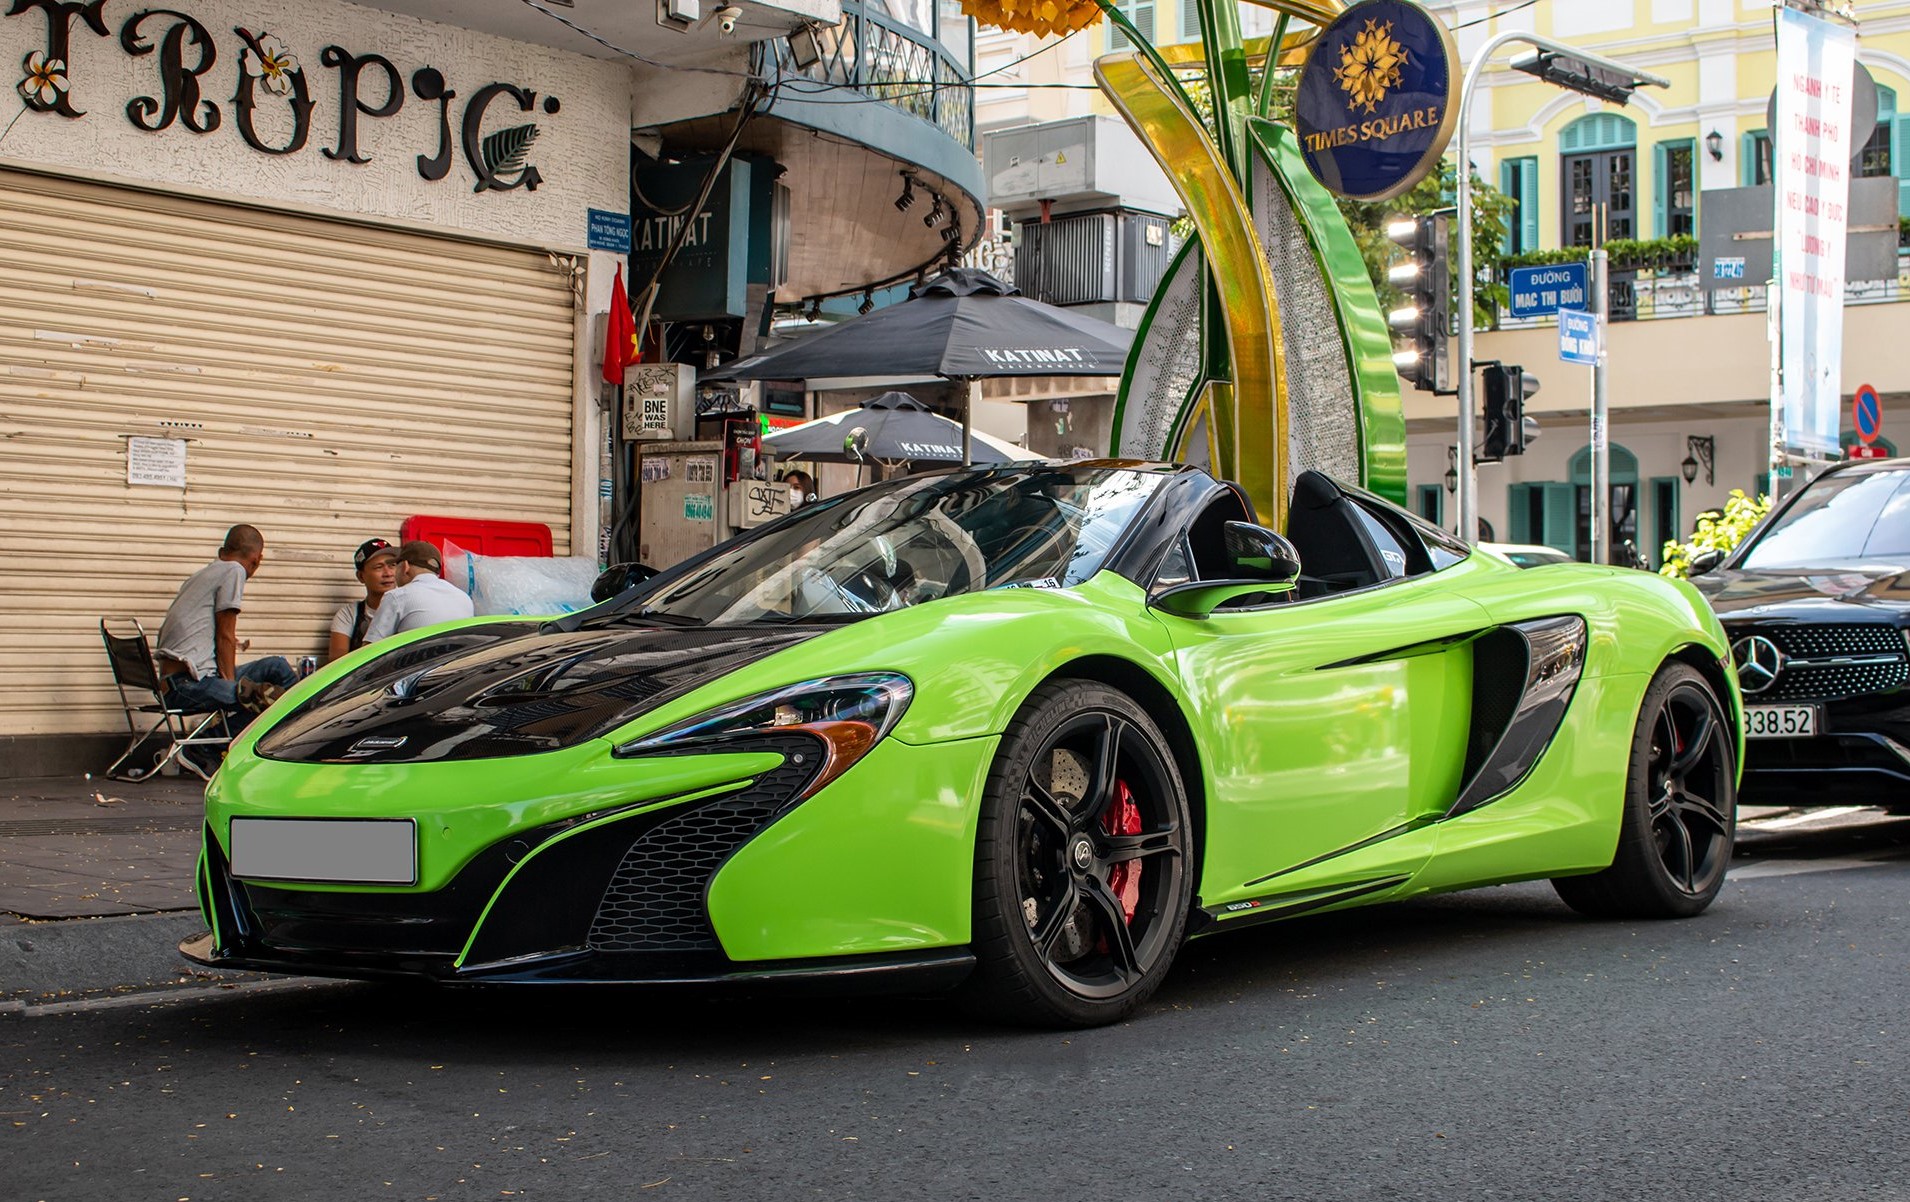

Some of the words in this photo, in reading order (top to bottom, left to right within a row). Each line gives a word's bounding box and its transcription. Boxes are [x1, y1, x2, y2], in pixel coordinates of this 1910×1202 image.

[1305, 123, 1357, 153] TIMES
[1360, 106, 1439, 141] SQUARE
[1531, 270, 1571, 286] ĐƯỜNG
[1515, 292, 1538, 311] MẠC
[1541, 290, 1557, 309] THỊ
[984, 348, 1083, 362] KATINAT
[644, 400, 666, 413] BNE
[645, 413, 666, 421] WAS
